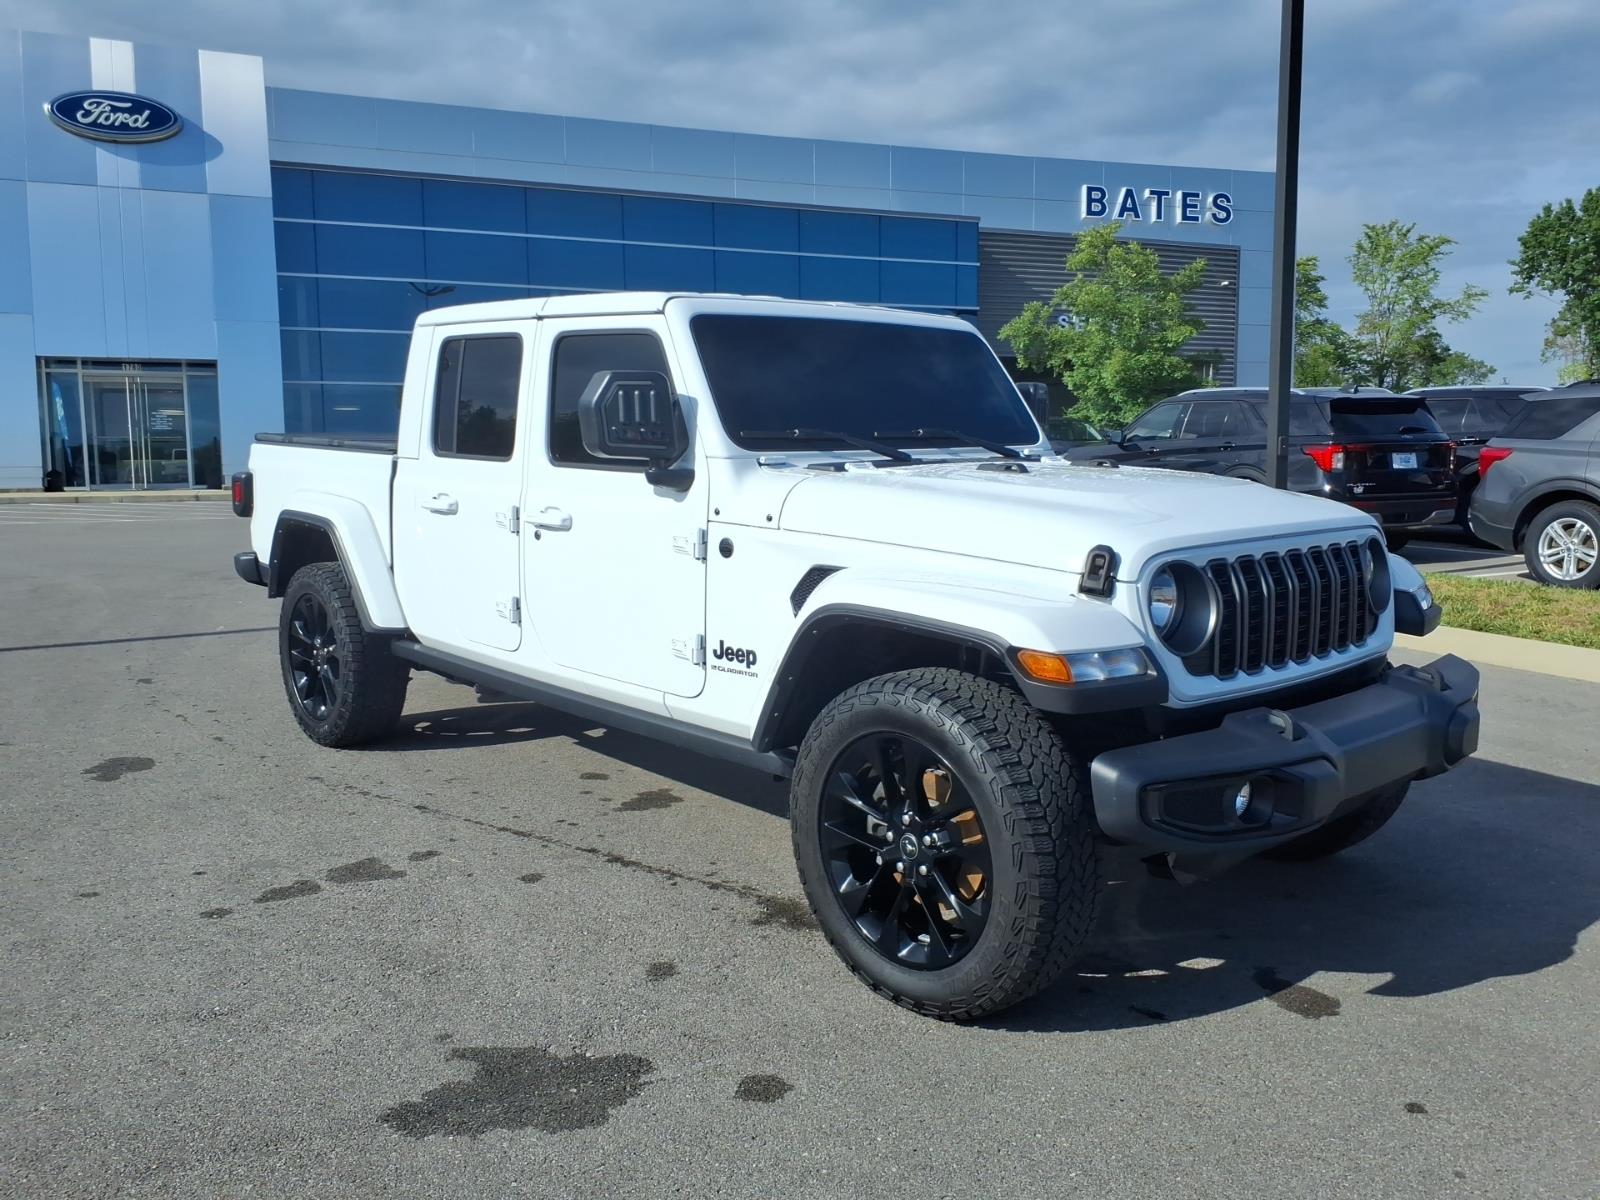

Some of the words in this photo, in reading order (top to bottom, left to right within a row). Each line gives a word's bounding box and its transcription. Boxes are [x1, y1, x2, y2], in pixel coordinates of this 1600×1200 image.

[76, 98, 151, 128] Ford
[1081, 184, 1234, 225] BATES
[712, 639, 757, 669] Jeep
[717, 665, 759, 679] GLADIATOR
